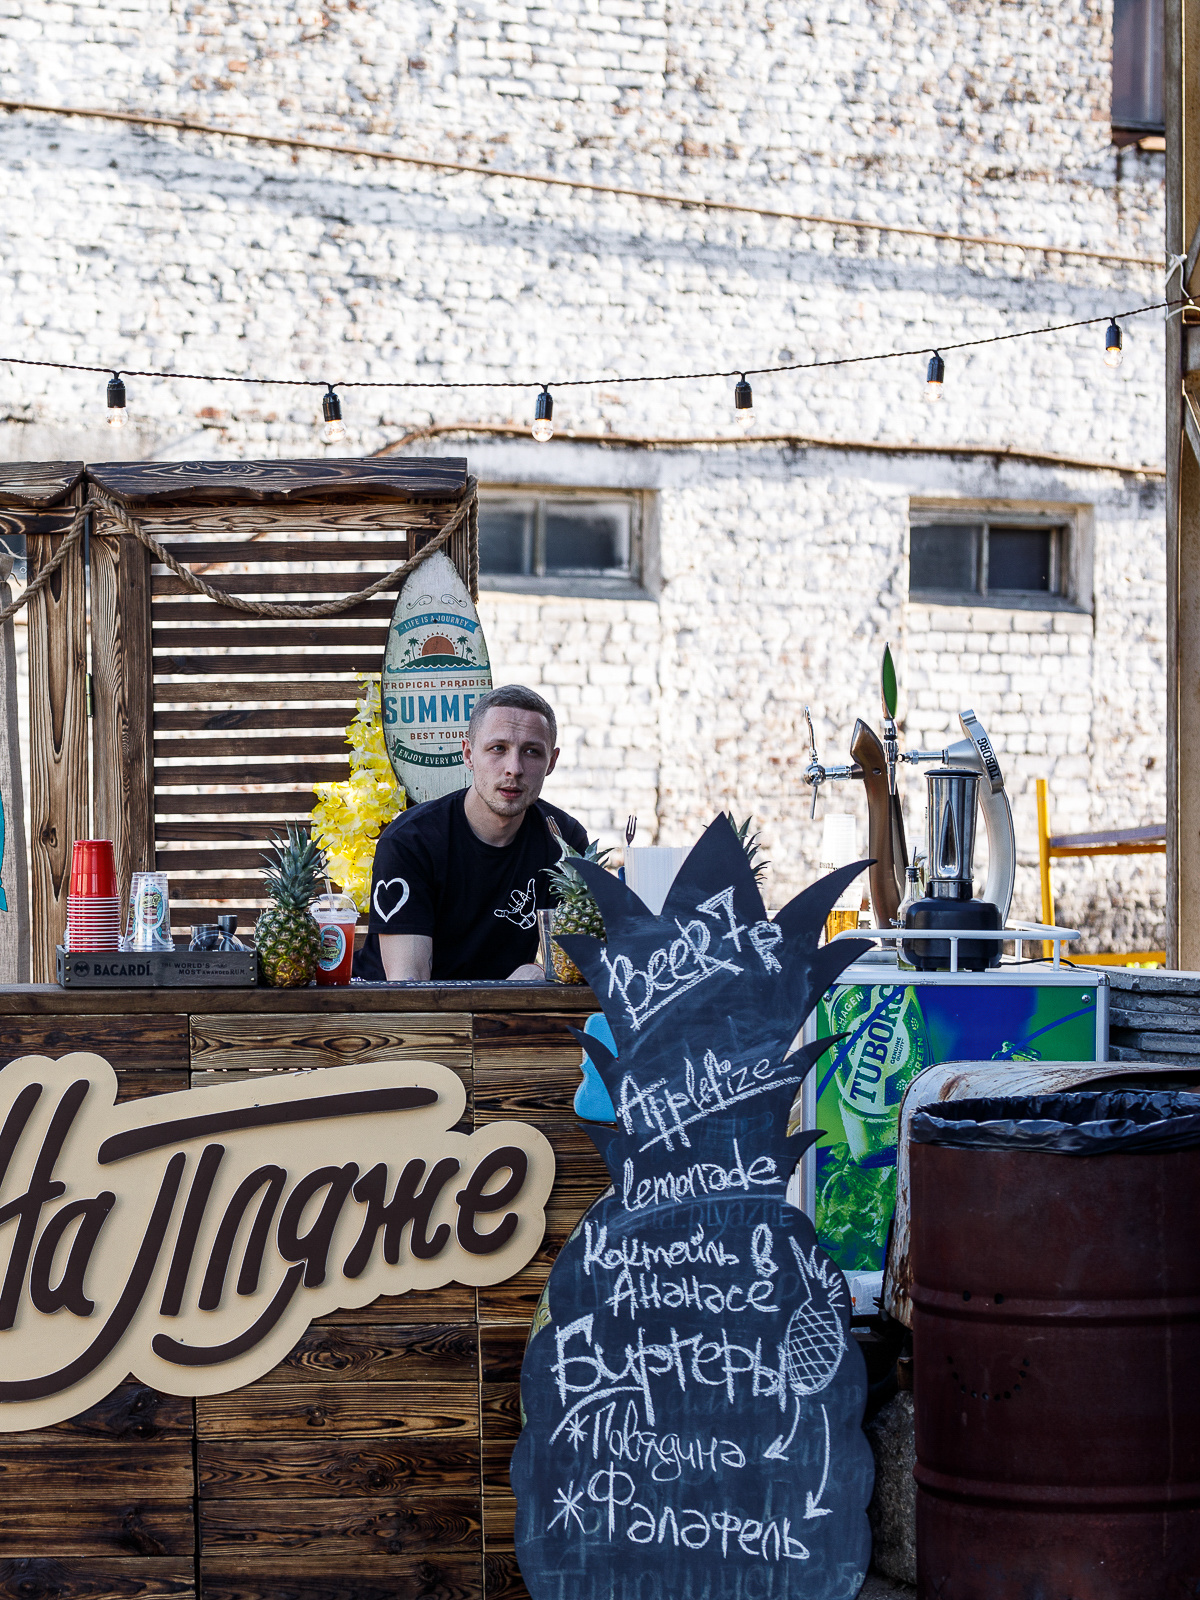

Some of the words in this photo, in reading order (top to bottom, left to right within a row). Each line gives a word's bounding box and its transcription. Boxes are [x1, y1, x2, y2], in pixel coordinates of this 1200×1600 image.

[404, 618, 419, 629] LIFE
[436, 616, 469, 628] JOURNEY
[384, 681, 436, 690] TROPICAL
[440, 678, 492, 688] PARADISE
[384, 693, 487, 725] SUMME
[410, 732, 436, 740] BEST
[439, 731, 469, 739] TOURS
[398, 750, 424, 763] ENJOY
[425, 756, 449, 765] EVERY
[977, 737, 1000, 780] TUBORG
[890, 1037, 902, 1065] GENUINE
[911, 1037, 924, 1078] GREEN
[587, 1461, 810, 1560] Фалафель
